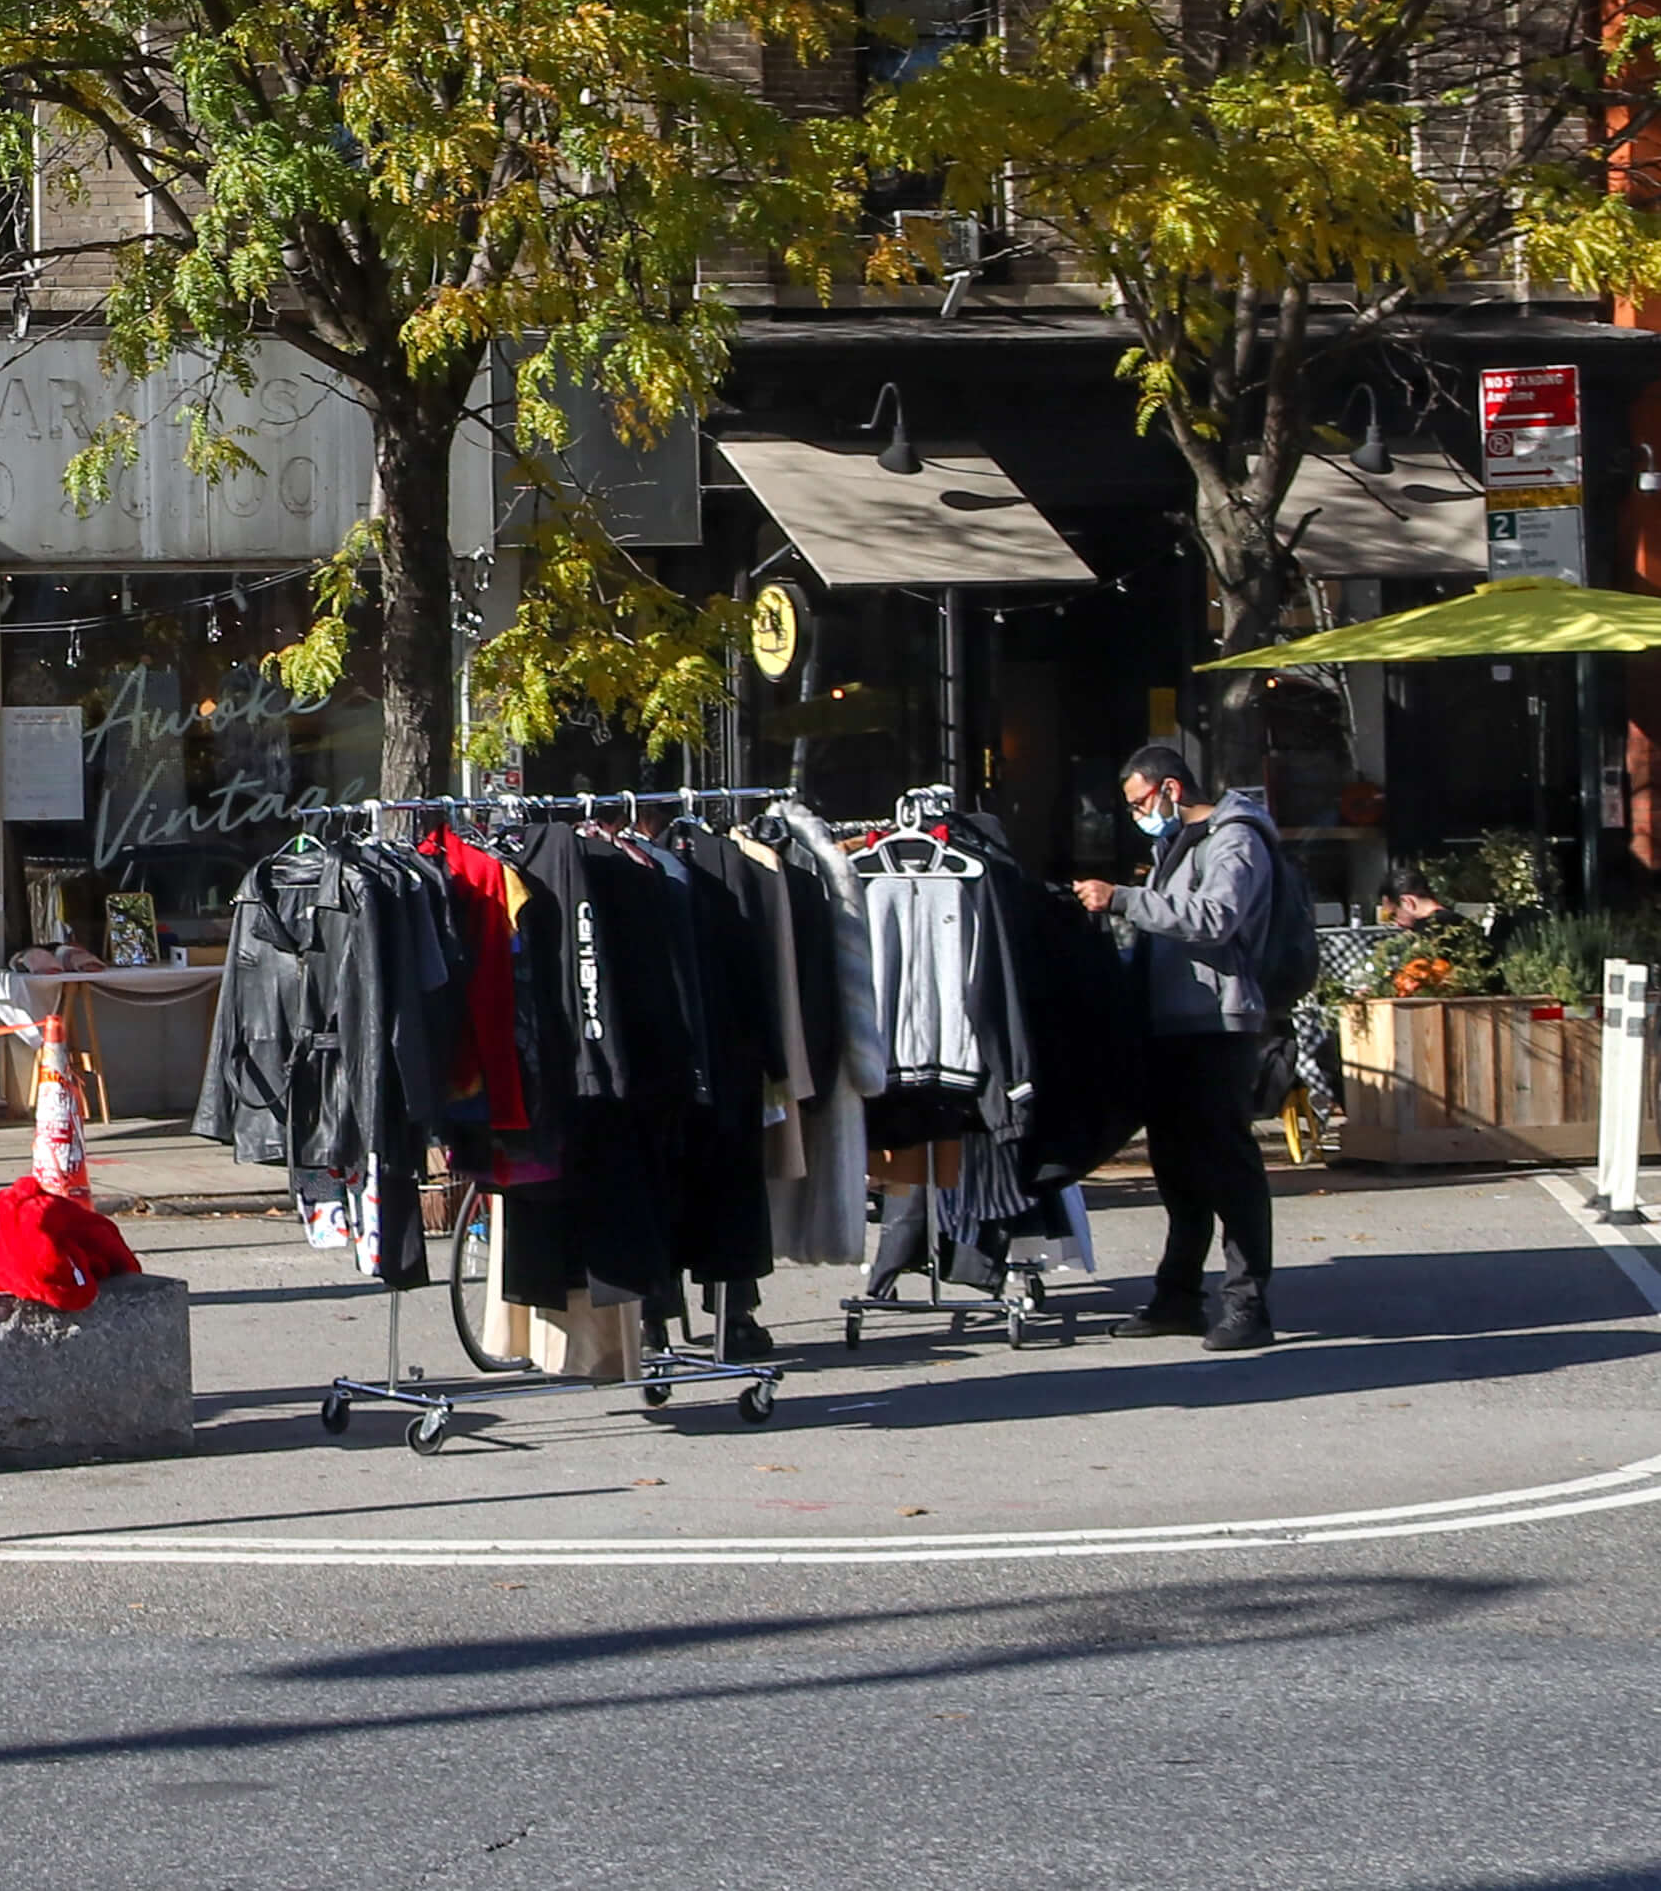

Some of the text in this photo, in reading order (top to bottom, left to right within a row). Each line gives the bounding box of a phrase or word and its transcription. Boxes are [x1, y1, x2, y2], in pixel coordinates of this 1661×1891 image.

[1484, 373, 1564, 389] NO STANDING
[1493, 515, 1510, 539] 2
[82, 662, 332, 763] Awoke
